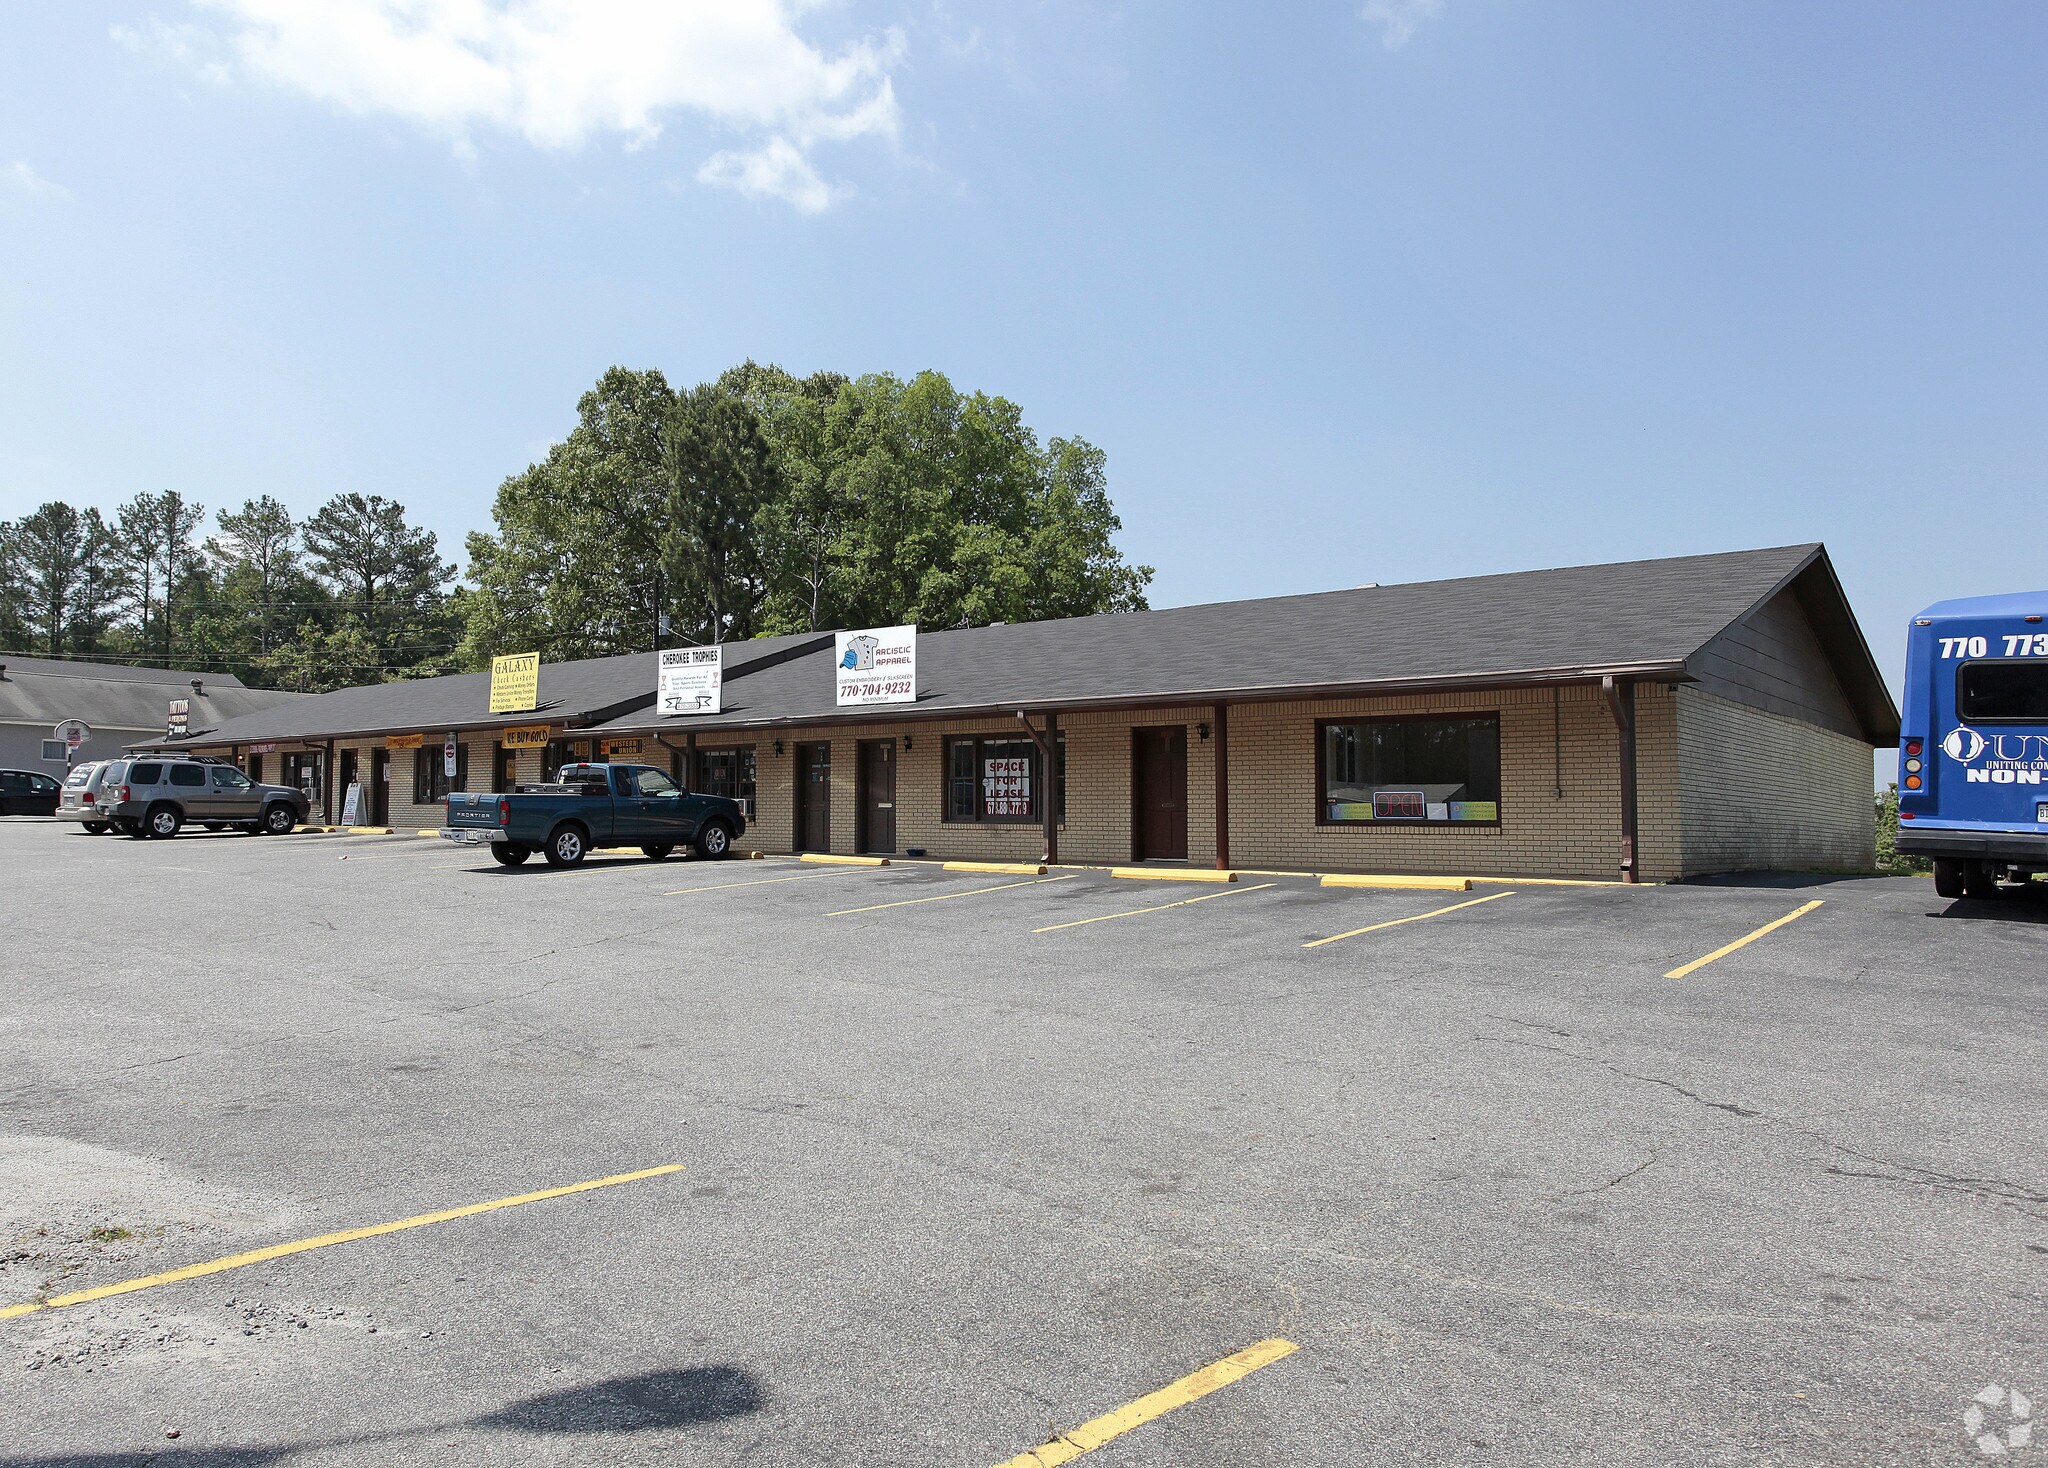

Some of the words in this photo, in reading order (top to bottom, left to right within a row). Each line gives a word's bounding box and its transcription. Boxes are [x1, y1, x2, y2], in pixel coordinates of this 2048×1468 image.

[1938, 636, 1987, 659] 770
[663, 652, 689, 665] CHEROKEE
[692, 650, 718, 663] TROPHIES
[876, 657, 912, 666] APPAREL
[495, 659, 535, 674] GALAXY
[516, 731, 530, 744] BUY
[530, 730, 548, 743] GOLD
[610, 740, 637, 748] WESTERN
[990, 761, 1025, 772] SPACE
[1986, 760, 2028, 770] UNITING
[996, 776, 1018, 785] FOR
[990, 789, 1025, 798] LEASE
[1377, 794, 1422, 816] OPEN
